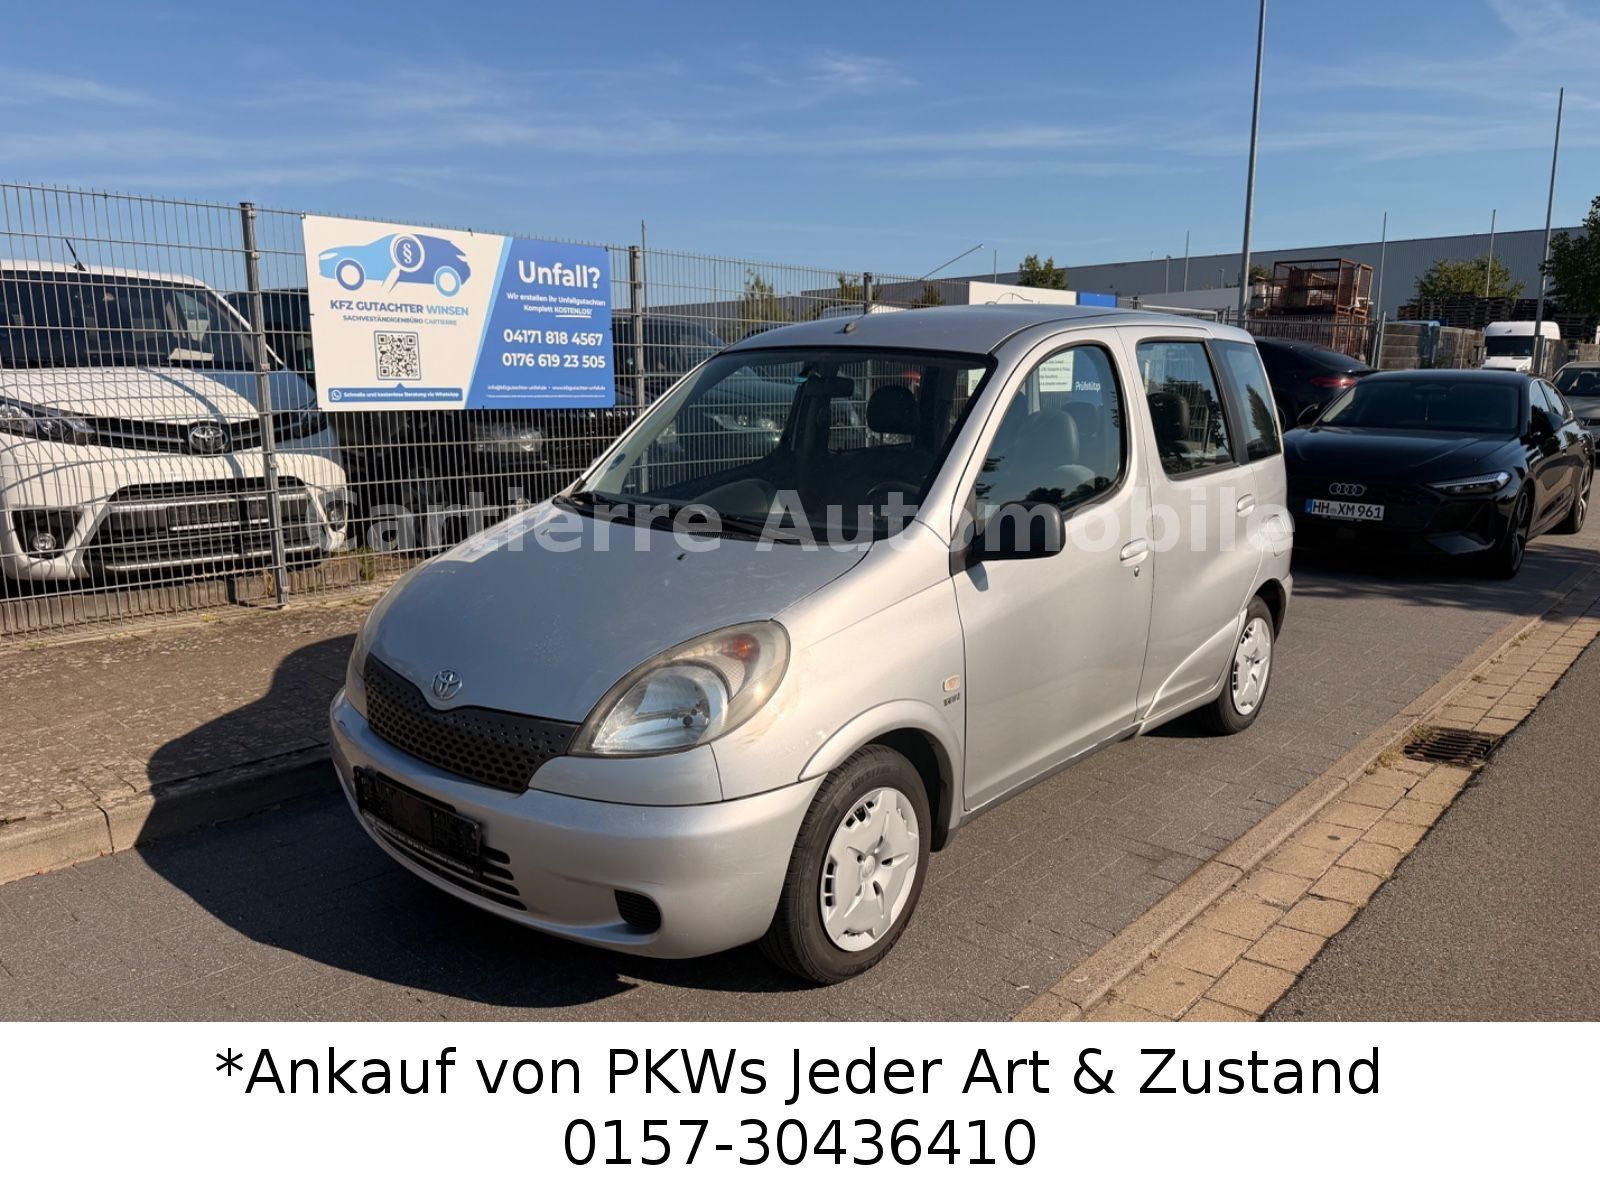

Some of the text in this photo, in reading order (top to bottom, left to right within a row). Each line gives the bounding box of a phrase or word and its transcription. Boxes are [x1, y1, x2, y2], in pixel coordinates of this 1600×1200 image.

[518, 260, 601, 289] Unfall?
[506, 292, 519, 300] Wir
[520, 294, 548, 302] erstellen
[559, 296, 606, 306] Unfallgutachten
[330, 300, 470, 316] KFZ GUTACHTER WINSEN
[523, 304, 553, 313] Komplett
[503, 329, 603, 346] 04171 818 4567
[502, 353, 606, 368] 0176 619 23 505
[1312, 500, 1330, 514] HH
[1337, 503, 1355, 516] XM
[1357, 505, 1382, 519] 961
